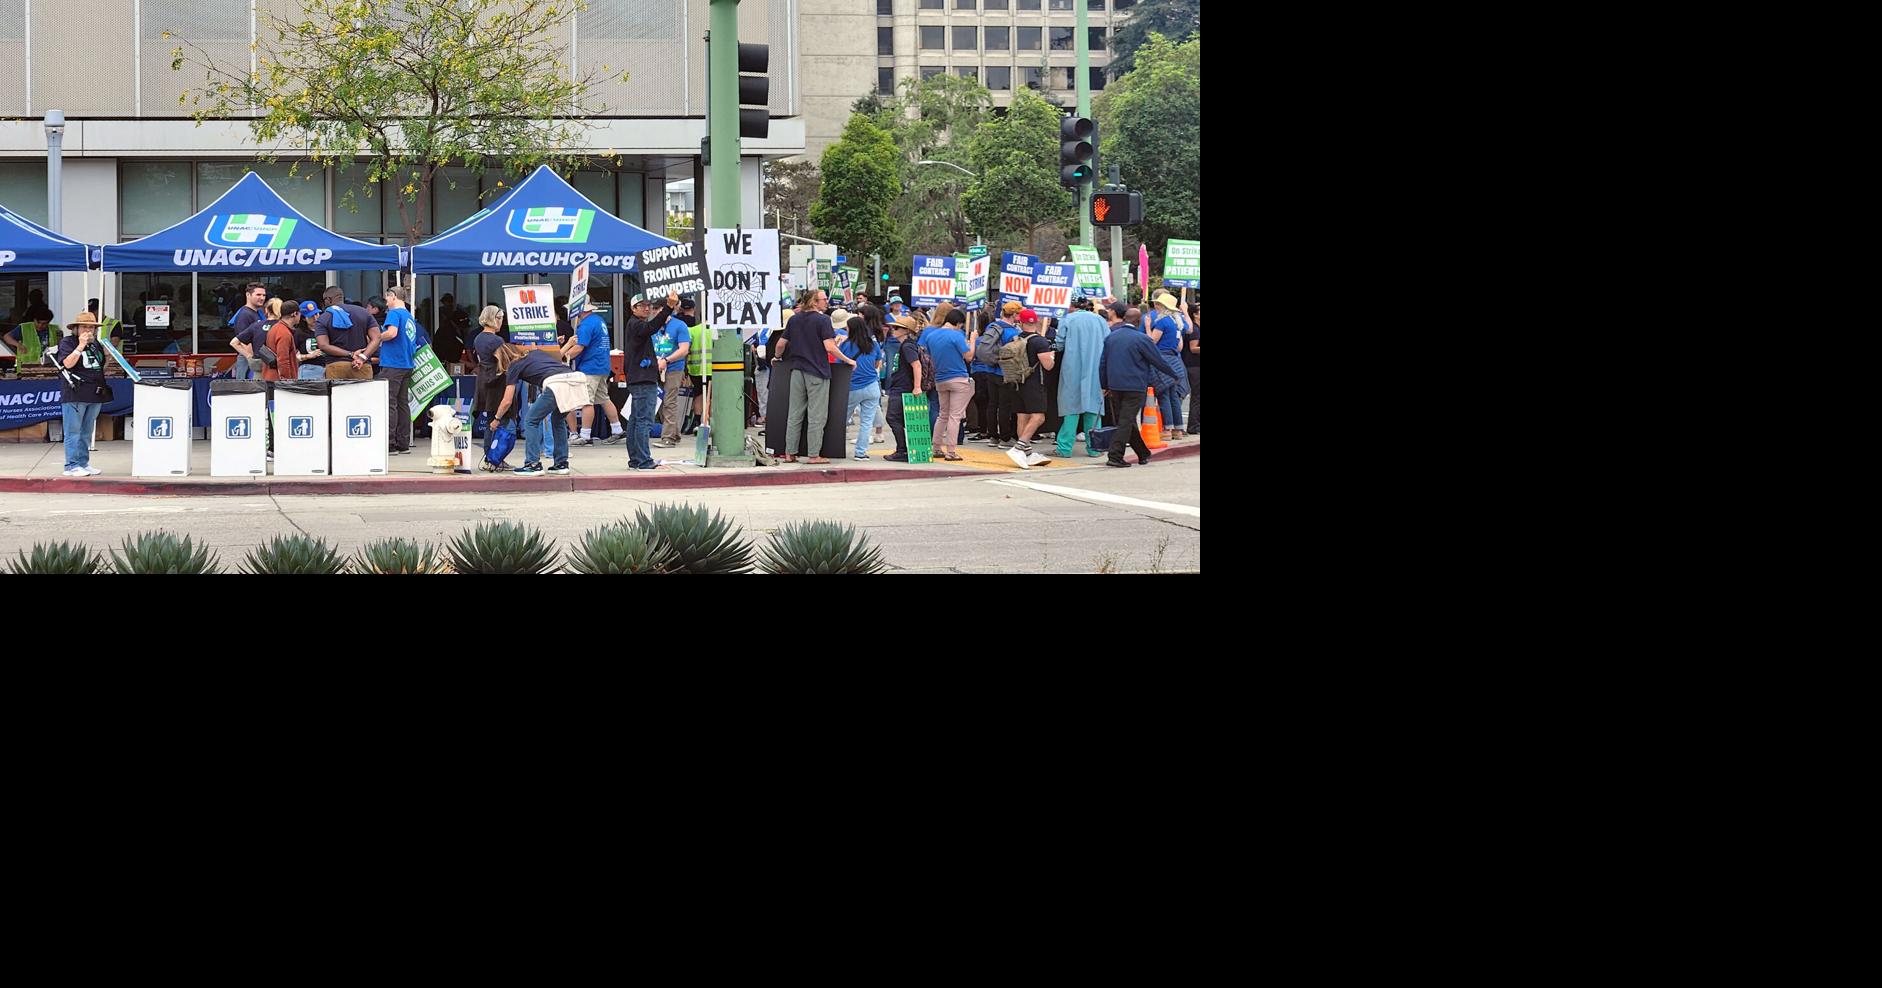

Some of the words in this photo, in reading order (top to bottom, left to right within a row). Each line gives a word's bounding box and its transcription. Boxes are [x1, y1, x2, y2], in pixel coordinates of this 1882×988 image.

[723, 233, 752, 255] WE
[173, 249, 333, 267] UNAC/UHCP
[482, 252, 636, 270] UNACUHCP.org
[642, 242, 694, 265] SUPPORT
[1012, 254, 1029, 266] FAIR
[919, 266, 951, 276] CONTRACT
[925, 258, 944, 268] FAIR
[1006, 263, 1034, 275] CONTRACT
[1044, 265, 1063, 276] FAIR
[643, 261, 701, 284] FRONTLINE
[713, 270, 771, 291] DON'T
[1036, 274, 1069, 285] CONTRACT
[646, 278, 705, 301] PROVIDERS
[918, 279, 951, 296] NOW
[969, 275, 986, 292] STRIKE
[519, 289, 537, 305] ON
[1033, 287, 1068, 305] NOW
[512, 305, 550, 320] STRIKE
[713, 302, 773, 325] PLAY
[416, 378, 436, 395] Strike
